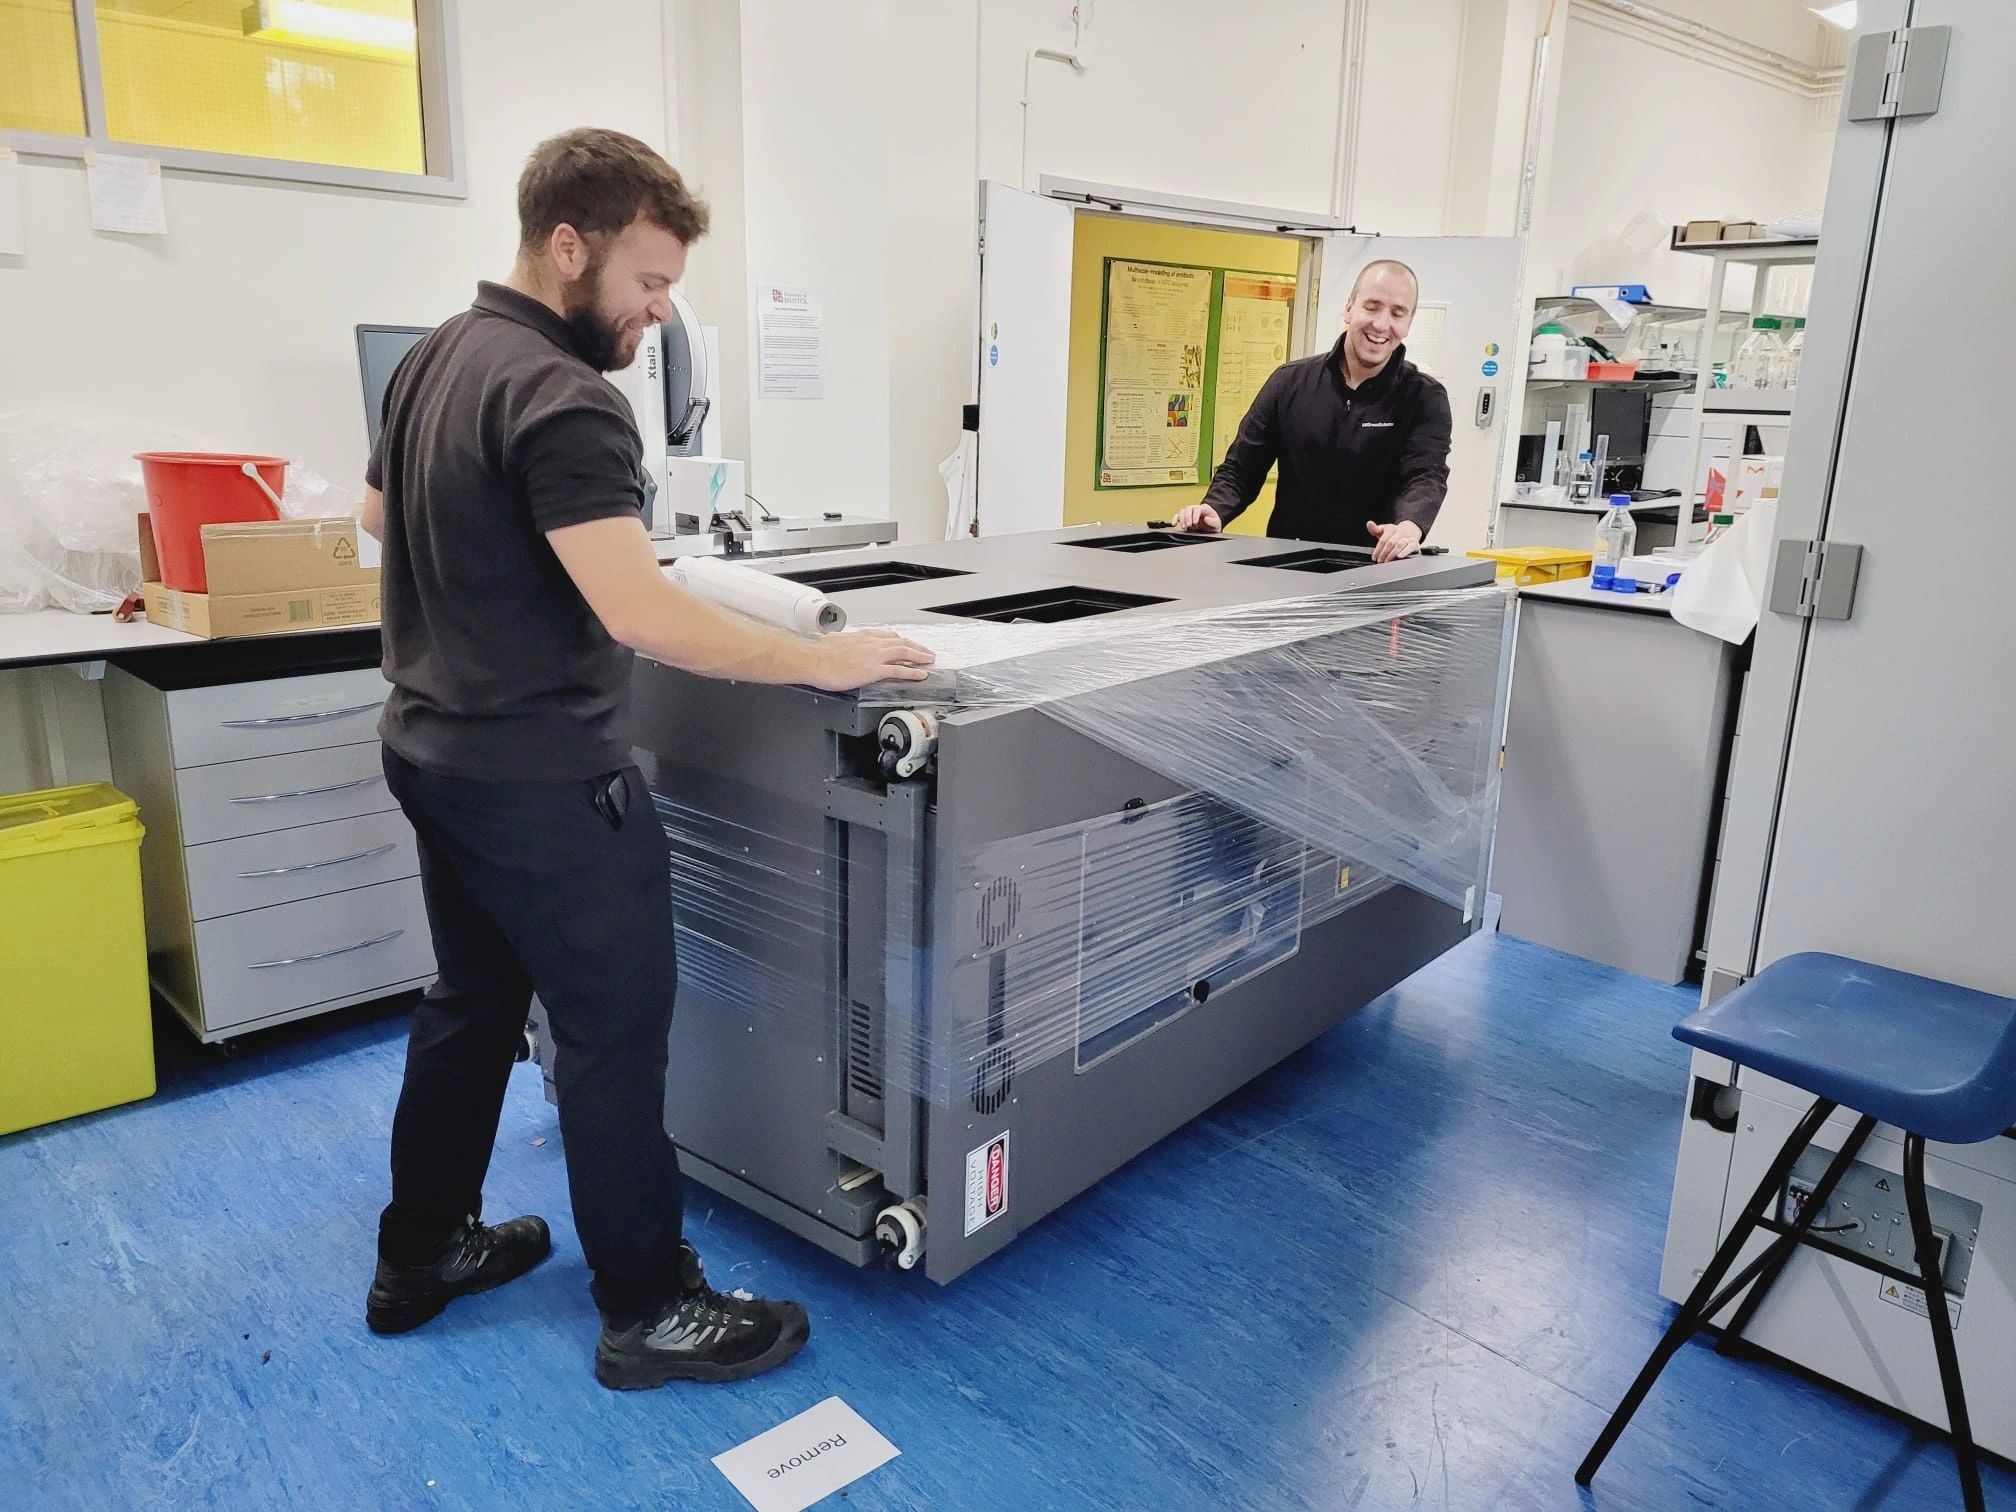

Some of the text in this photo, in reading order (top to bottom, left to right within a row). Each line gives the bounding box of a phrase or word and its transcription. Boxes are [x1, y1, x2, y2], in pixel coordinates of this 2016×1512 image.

[647, 345, 657, 380] Xtal3
[990, 1149, 1001, 1208] DANGER
[767, 1433, 848, 1480] Remove
